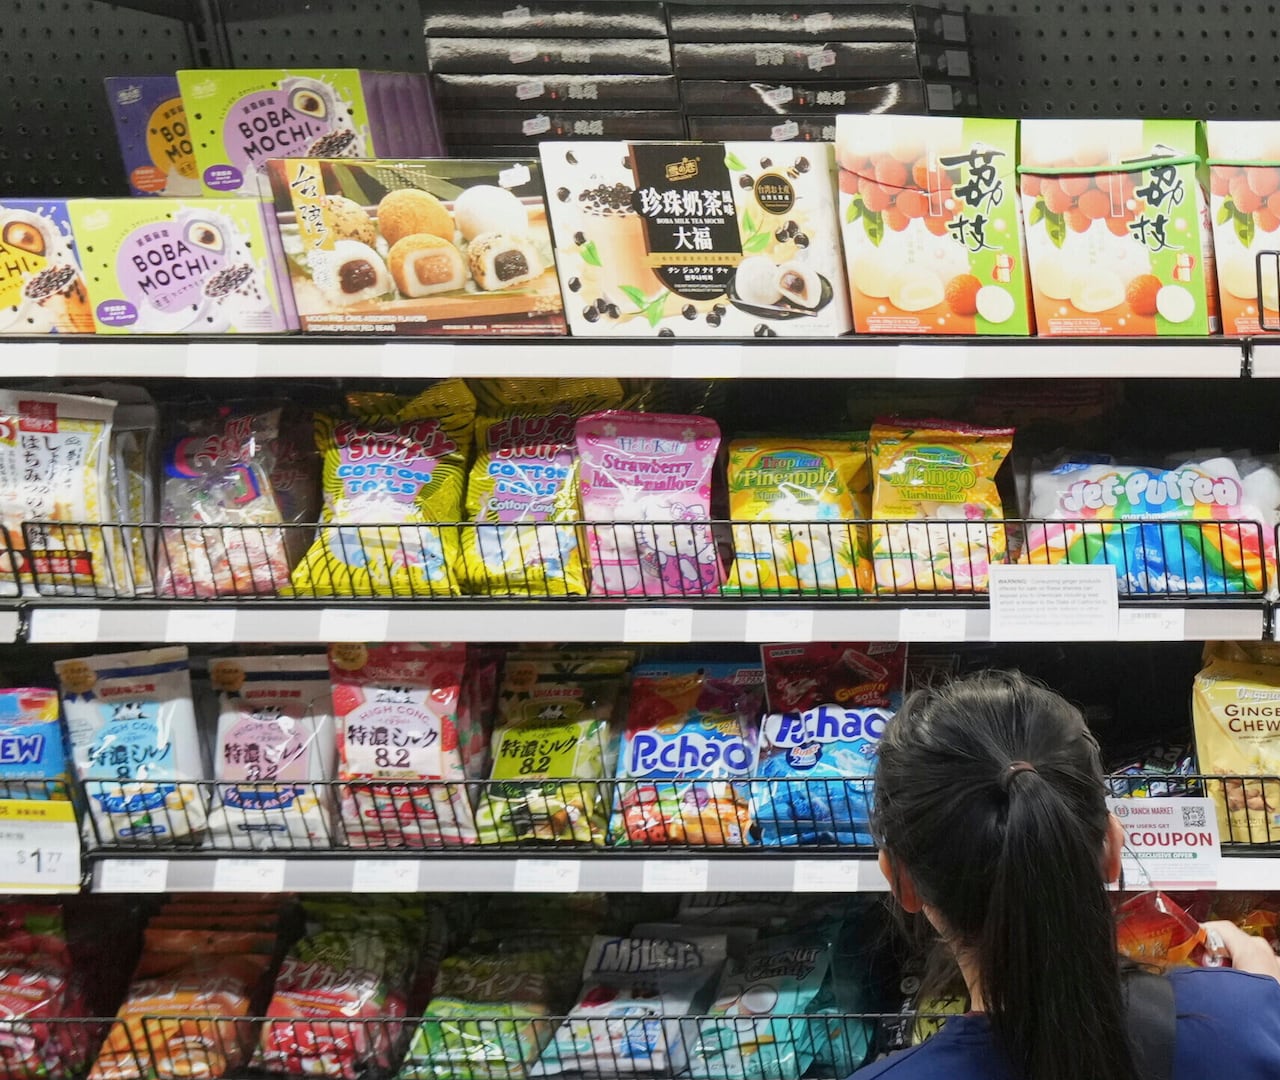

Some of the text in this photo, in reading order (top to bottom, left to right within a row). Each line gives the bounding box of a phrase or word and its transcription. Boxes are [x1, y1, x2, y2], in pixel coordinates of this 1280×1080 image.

[238, 107, 296, 139] BOBA
[672, 226, 713, 251] 大福
[132, 240, 192, 273] BOBA
[338, 463, 431, 483] COTTON
[743, 467, 836, 490] Pineapple
[889, 466, 976, 491] Mango
[348, 479, 415, 495] TAILS
[498, 479, 557, 495] TAILS
[1062, 471, 1243, 514] Jet-Puffed
[347, 723, 441, 749] 特濃ミルク
[500, 735, 578, 760] 特濃ミルク
[374, 749, 410, 768] 8.2
[519, 756, 550, 775] 8.2
[1129, 832, 1213, 847] COUPON
